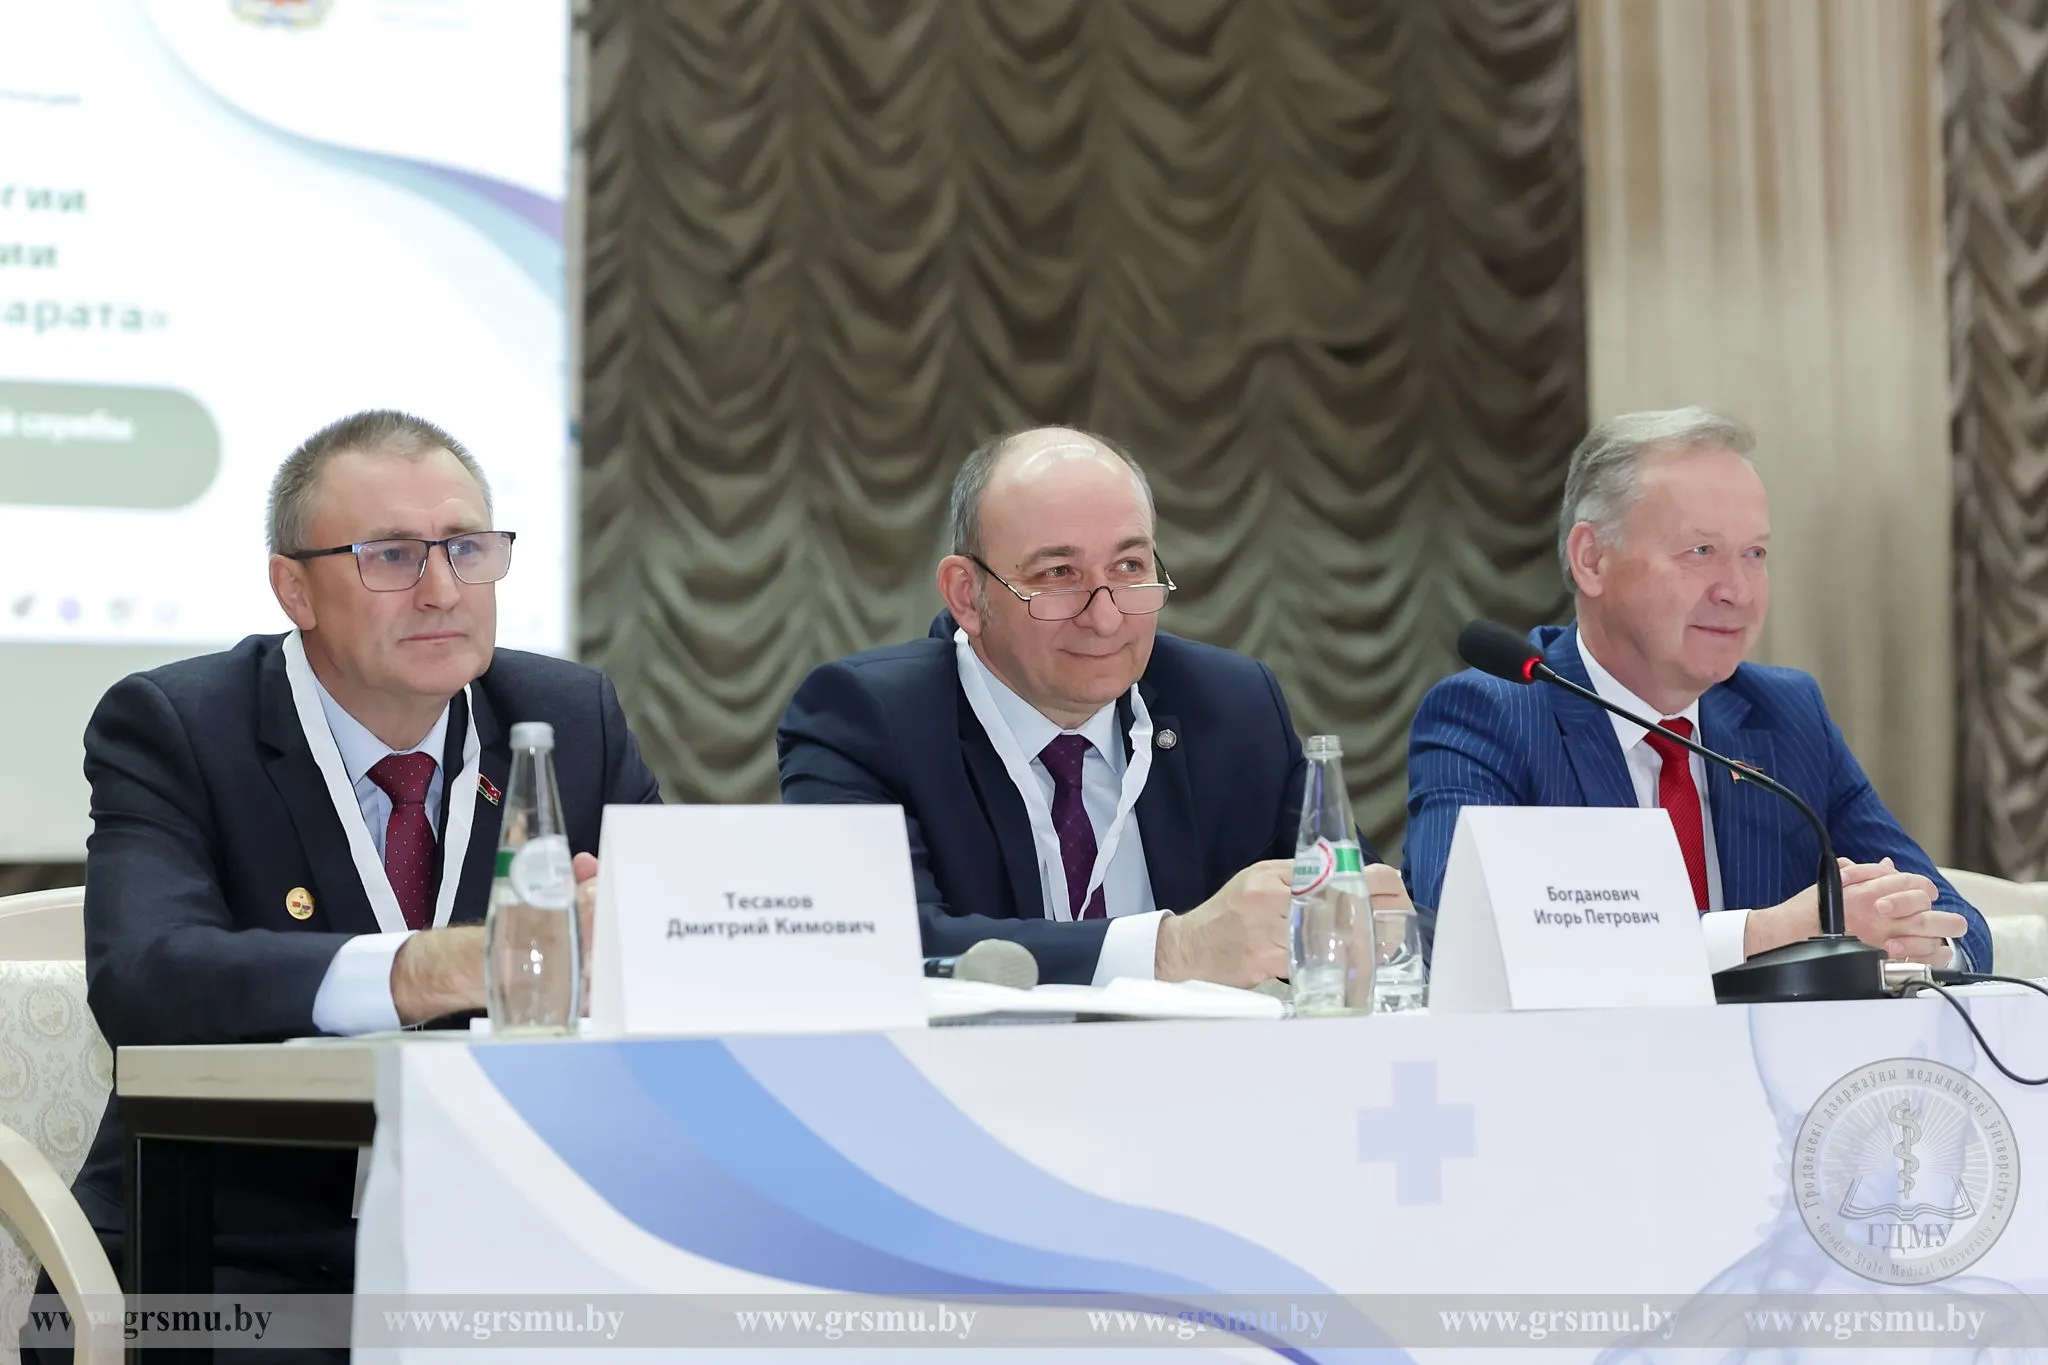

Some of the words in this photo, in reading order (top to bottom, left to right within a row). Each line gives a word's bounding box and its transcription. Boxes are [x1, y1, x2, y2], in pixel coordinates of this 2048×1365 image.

[723, 892, 814, 910] Тесаков
[1546, 886, 1640, 905] Богданович
[1534, 909, 1582, 928] Игорь
[1584, 908, 1661, 928] Петрович
[665, 917, 769, 940] Дмитрий
[775, 917, 876, 936] Кимович
